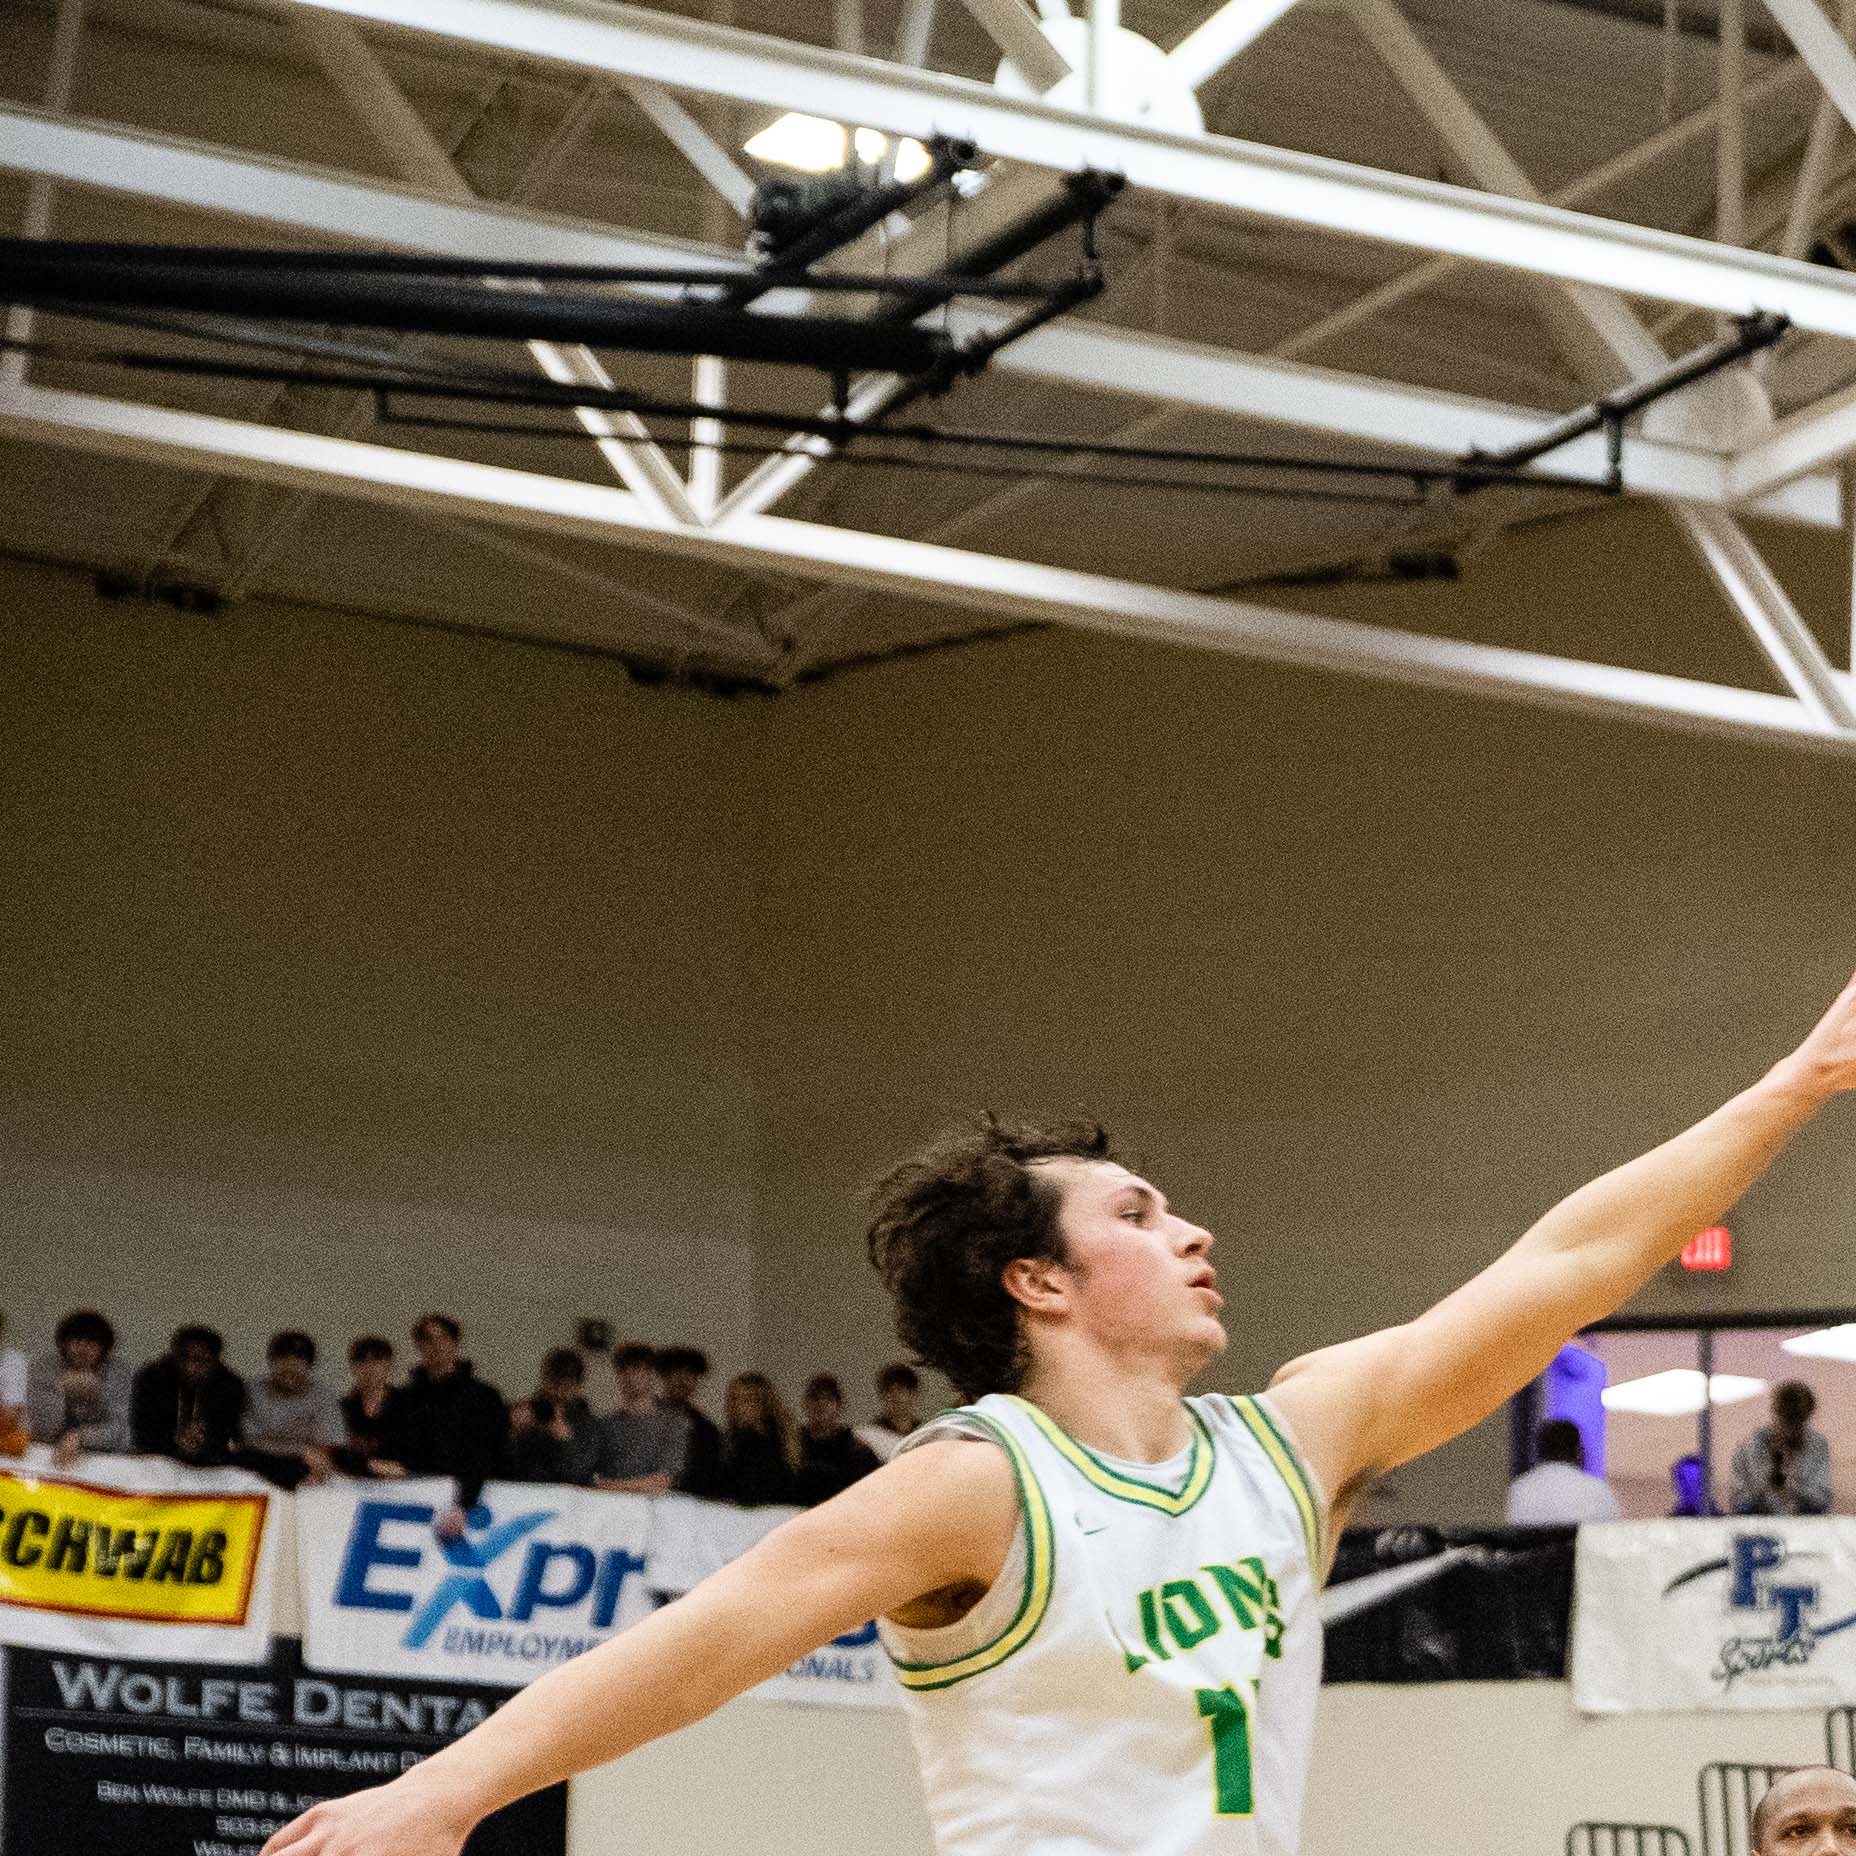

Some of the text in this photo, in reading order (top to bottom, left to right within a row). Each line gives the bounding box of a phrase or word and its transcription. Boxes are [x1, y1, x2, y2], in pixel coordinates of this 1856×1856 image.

[0, 1507, 229, 1587] CHWAB
[52, 1660, 490, 1735] WOLFE DENTA
[184, 1735, 267, 1766] FAMILY
[1194, 1682, 1256, 1816] 1
